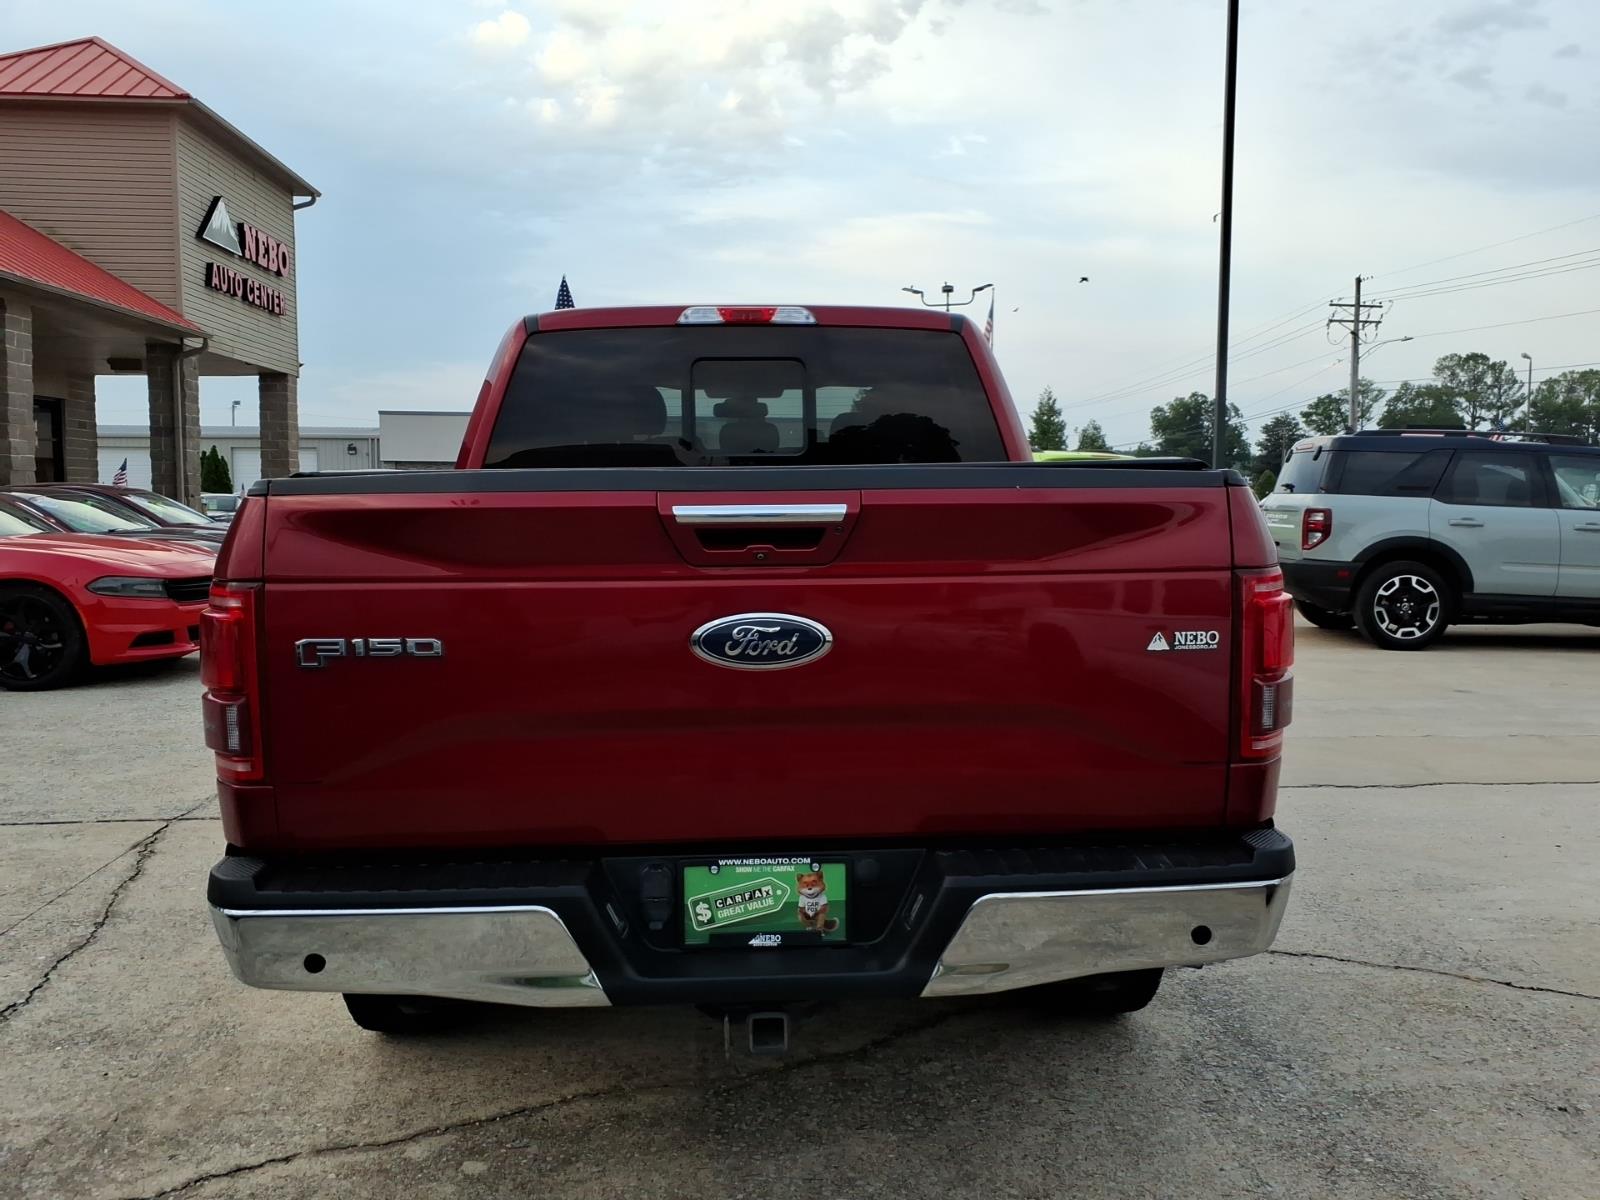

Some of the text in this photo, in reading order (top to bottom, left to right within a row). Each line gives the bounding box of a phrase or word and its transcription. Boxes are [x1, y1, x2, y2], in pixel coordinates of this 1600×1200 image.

[243, 223, 290, 279] NEBO
[211, 263, 288, 316] AUTO CENTER
[724, 625, 800, 656] Ford
[1173, 630, 1220, 645] NEBO
[718, 857, 811, 866] WWW.NEBOAUTO.COM
[715, 885, 773, 908] CARFAX
[717, 897, 775, 919] GREAT VALUE
